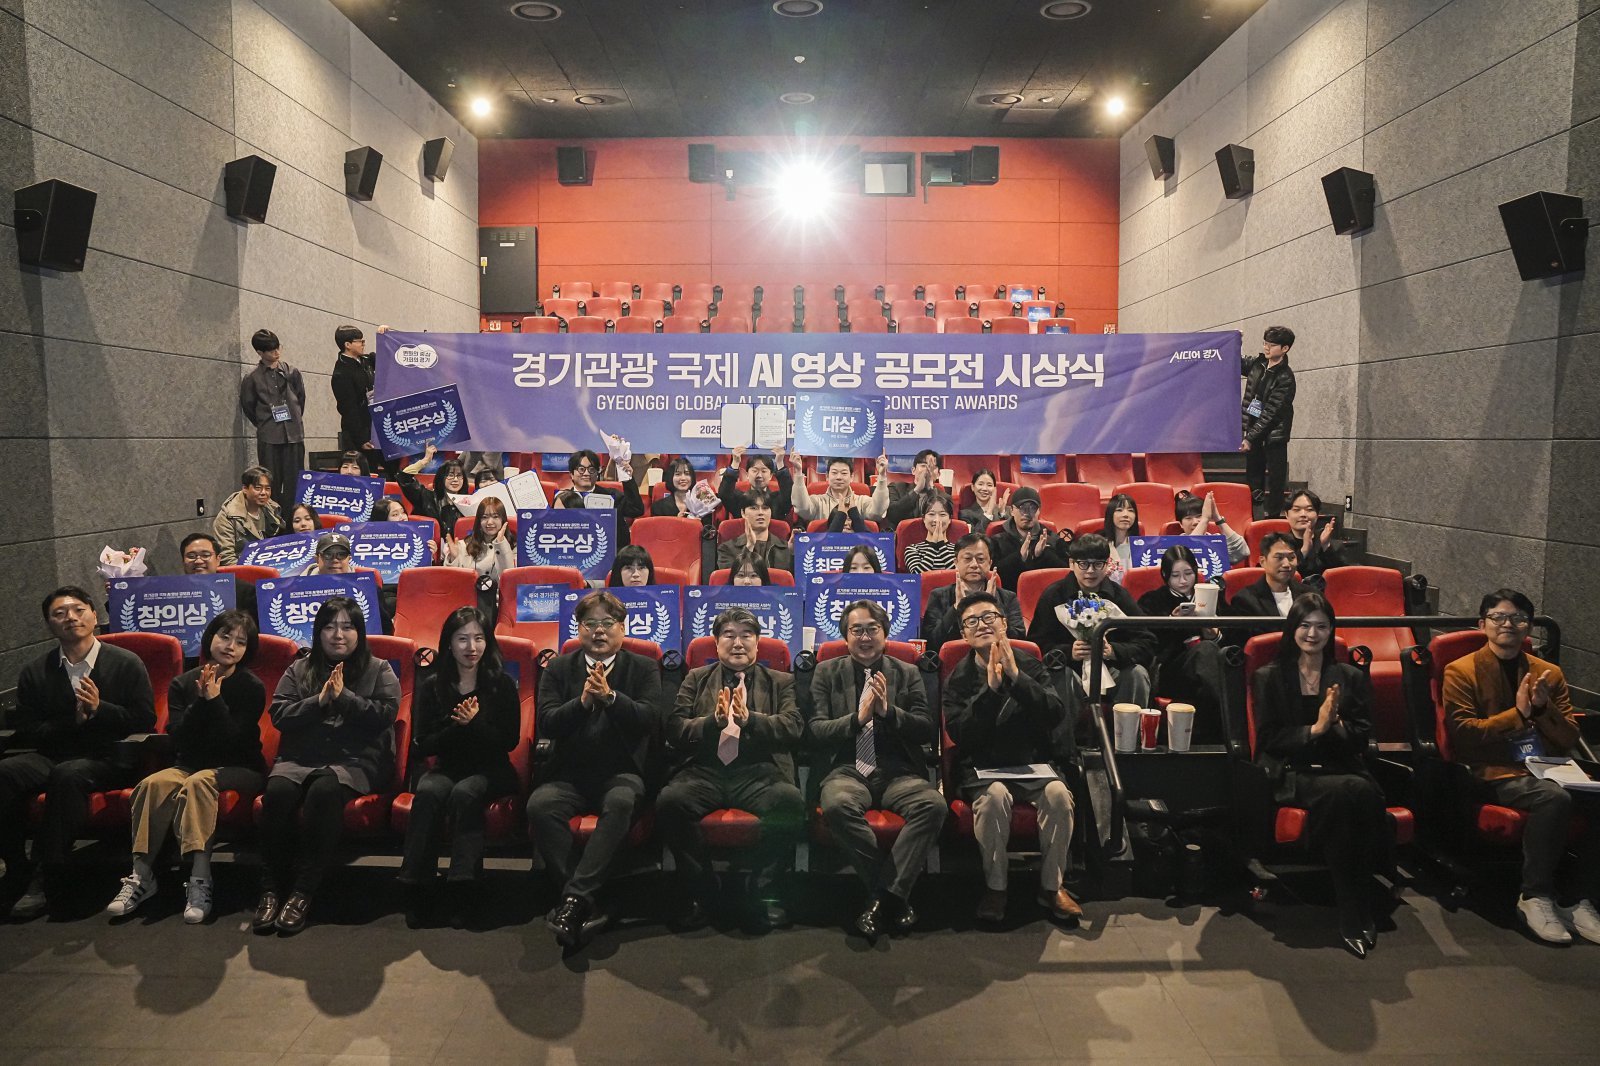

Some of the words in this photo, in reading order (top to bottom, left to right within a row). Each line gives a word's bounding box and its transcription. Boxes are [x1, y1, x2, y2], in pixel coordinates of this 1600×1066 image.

[1202, 349, 1222, 360] 경기
[512, 352, 658, 388] 경기관광
[667, 352, 739, 388] 국제
[748, 353, 783, 388] AI
[791, 352, 866, 389] 영상
[874, 353, 984, 389] 공모전
[995, 353, 1105, 388] 시상식
[596, 394, 669, 411] GYEONGGI
[884, 395, 949, 410] CONTEST
[954, 394, 1018, 410] AWARDS
[393, 410, 446, 435] 최우수상
[822, 415, 857, 434] 대상
[896, 423, 915, 435] 3관
[312, 494, 364, 512] 최우수상
[353, 543, 411, 560] 우수상
[537, 534, 594, 553] 우수상
[254, 546, 307, 565] 우수상
[137, 603, 208, 628] 창의상
[1519, 743, 1534, 754] VIP
